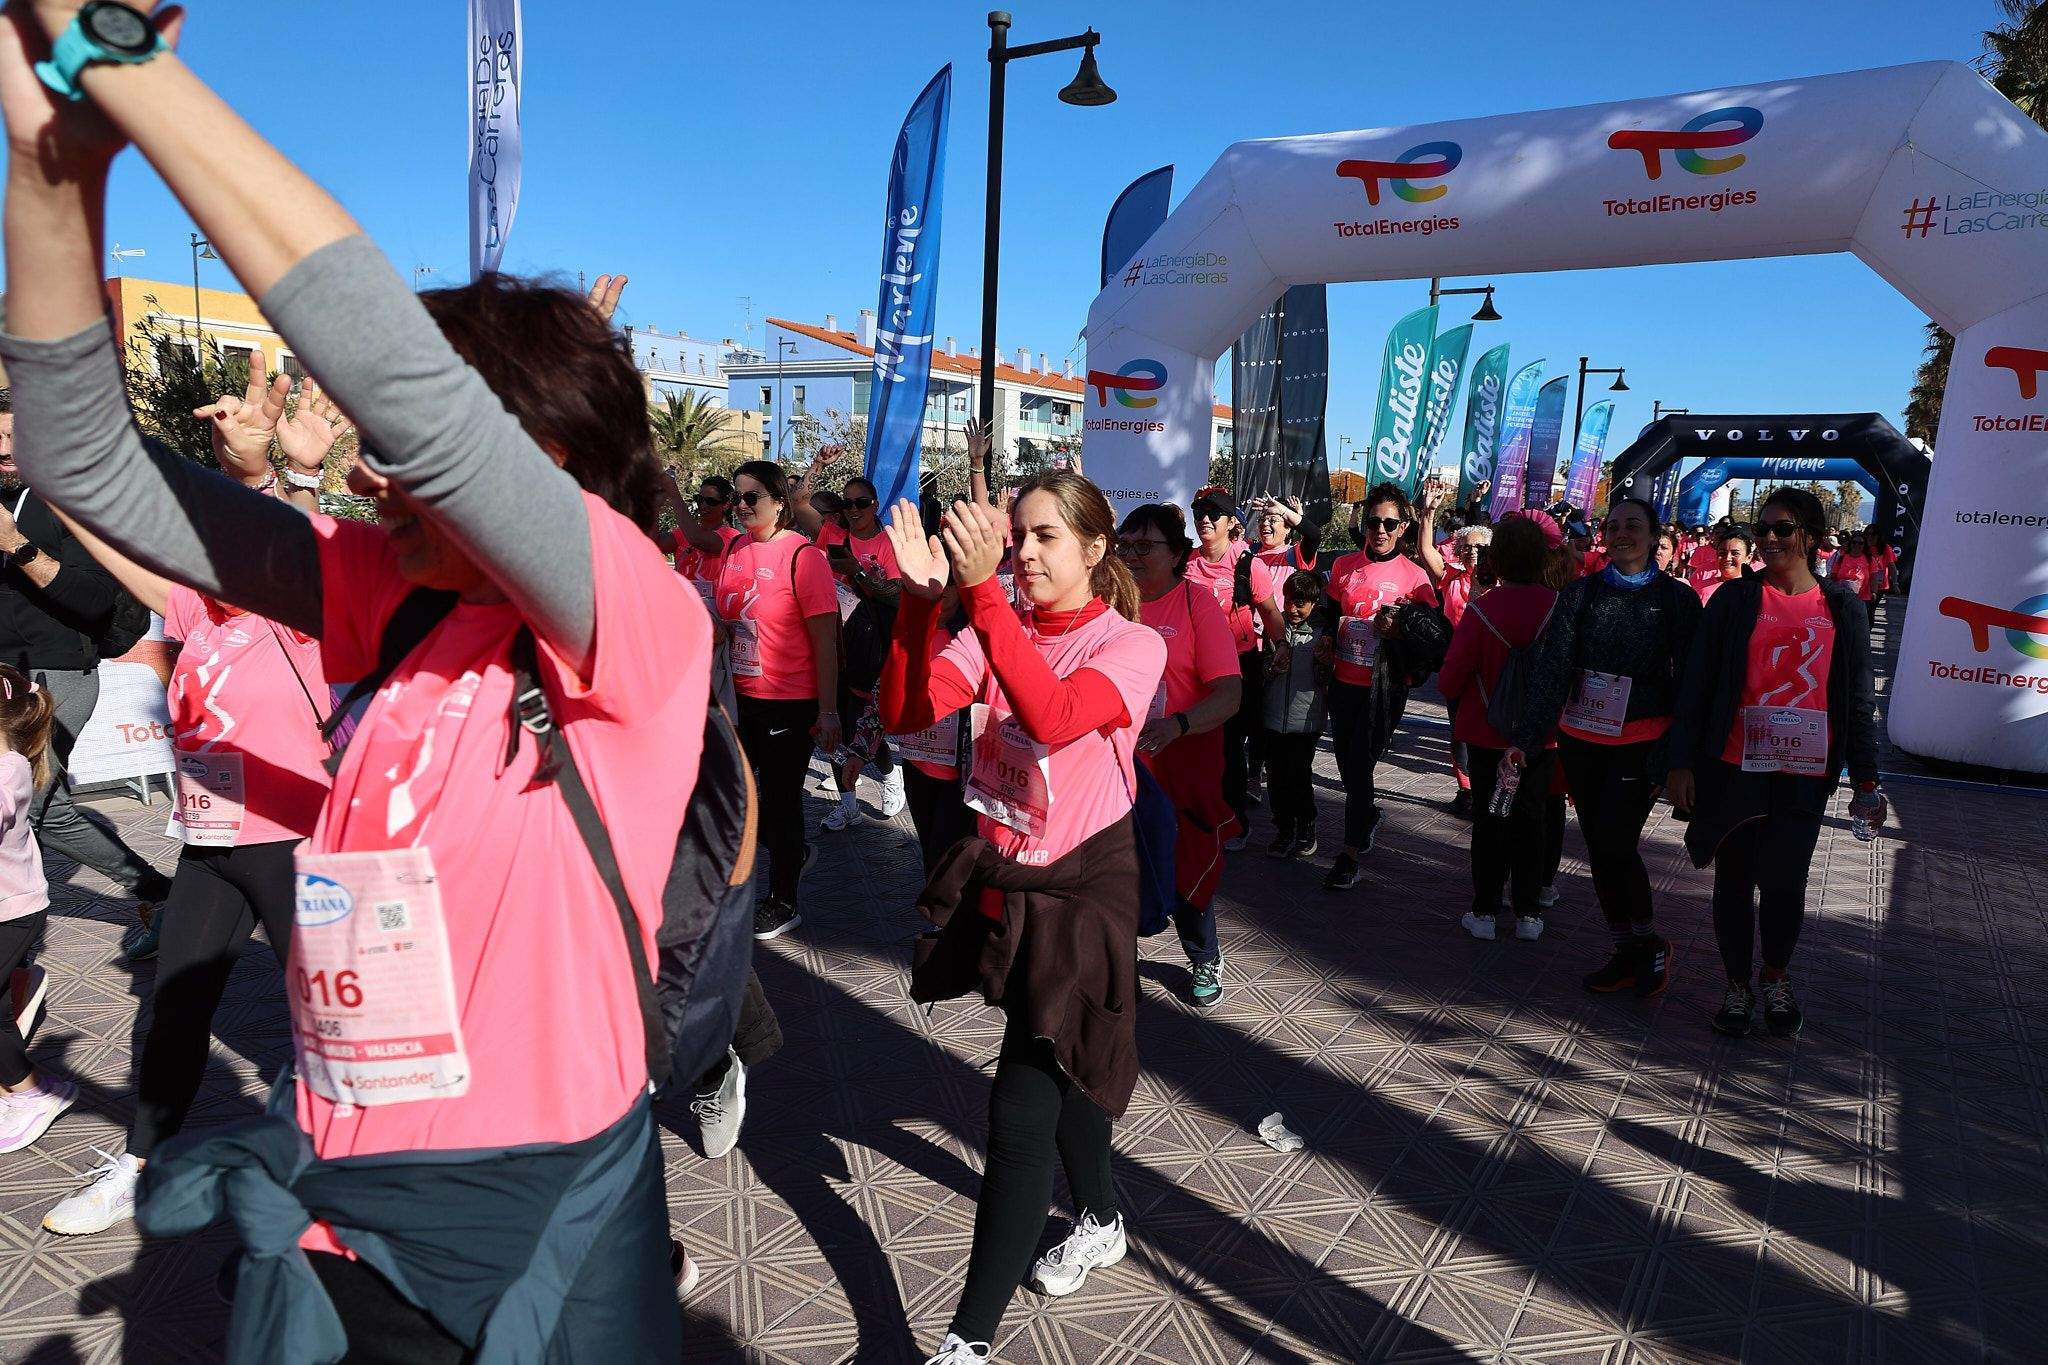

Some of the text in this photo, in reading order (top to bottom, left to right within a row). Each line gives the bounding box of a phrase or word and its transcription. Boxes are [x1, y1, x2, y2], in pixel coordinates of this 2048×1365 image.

[1602, 188, 1757, 216] TotalEnergies
[1333, 214, 1460, 237] TotalEnergies
[1143, 270, 1228, 286] LasCarreras
[874, 205, 932, 382] Marlene
[1283, 328, 1326, 337] VOLVO
[1240, 359, 1282, 367] VOLVO
[1285, 371, 1328, 381] VOLVO
[1376, 342, 1425, 482] Batiste
[1465, 373, 1500, 485] Batiste
[1695, 429, 1839, 441] VOLVO
[1955, 510, 2048, 530] totalener
[1582, 696, 1605, 710] 016
[1770, 735, 1802, 748] 016
[997, 761, 1029, 788] 016
[355, 1071, 436, 1091] Santander
